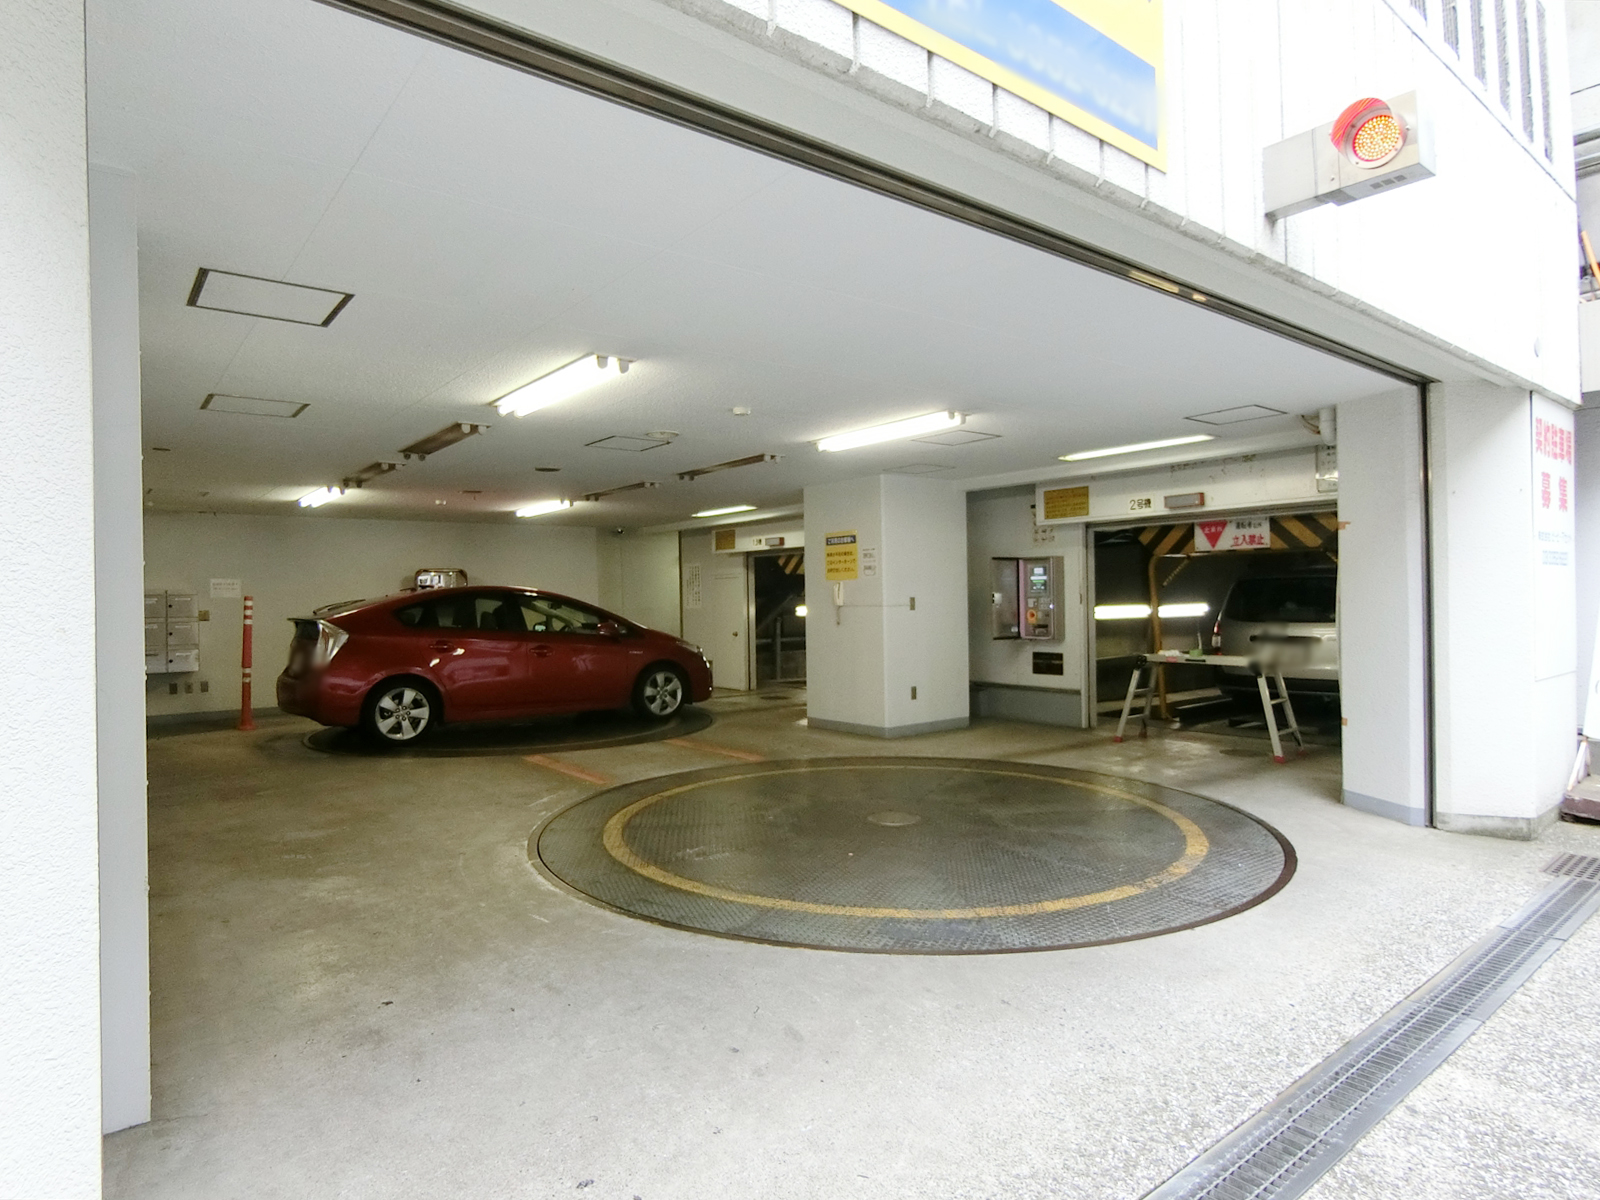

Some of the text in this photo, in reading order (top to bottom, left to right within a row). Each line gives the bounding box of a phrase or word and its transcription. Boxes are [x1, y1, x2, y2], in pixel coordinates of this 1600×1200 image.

[1129, 498, 1152, 510] 2号機
[1230, 534, 1265, 547] 立入禁止
